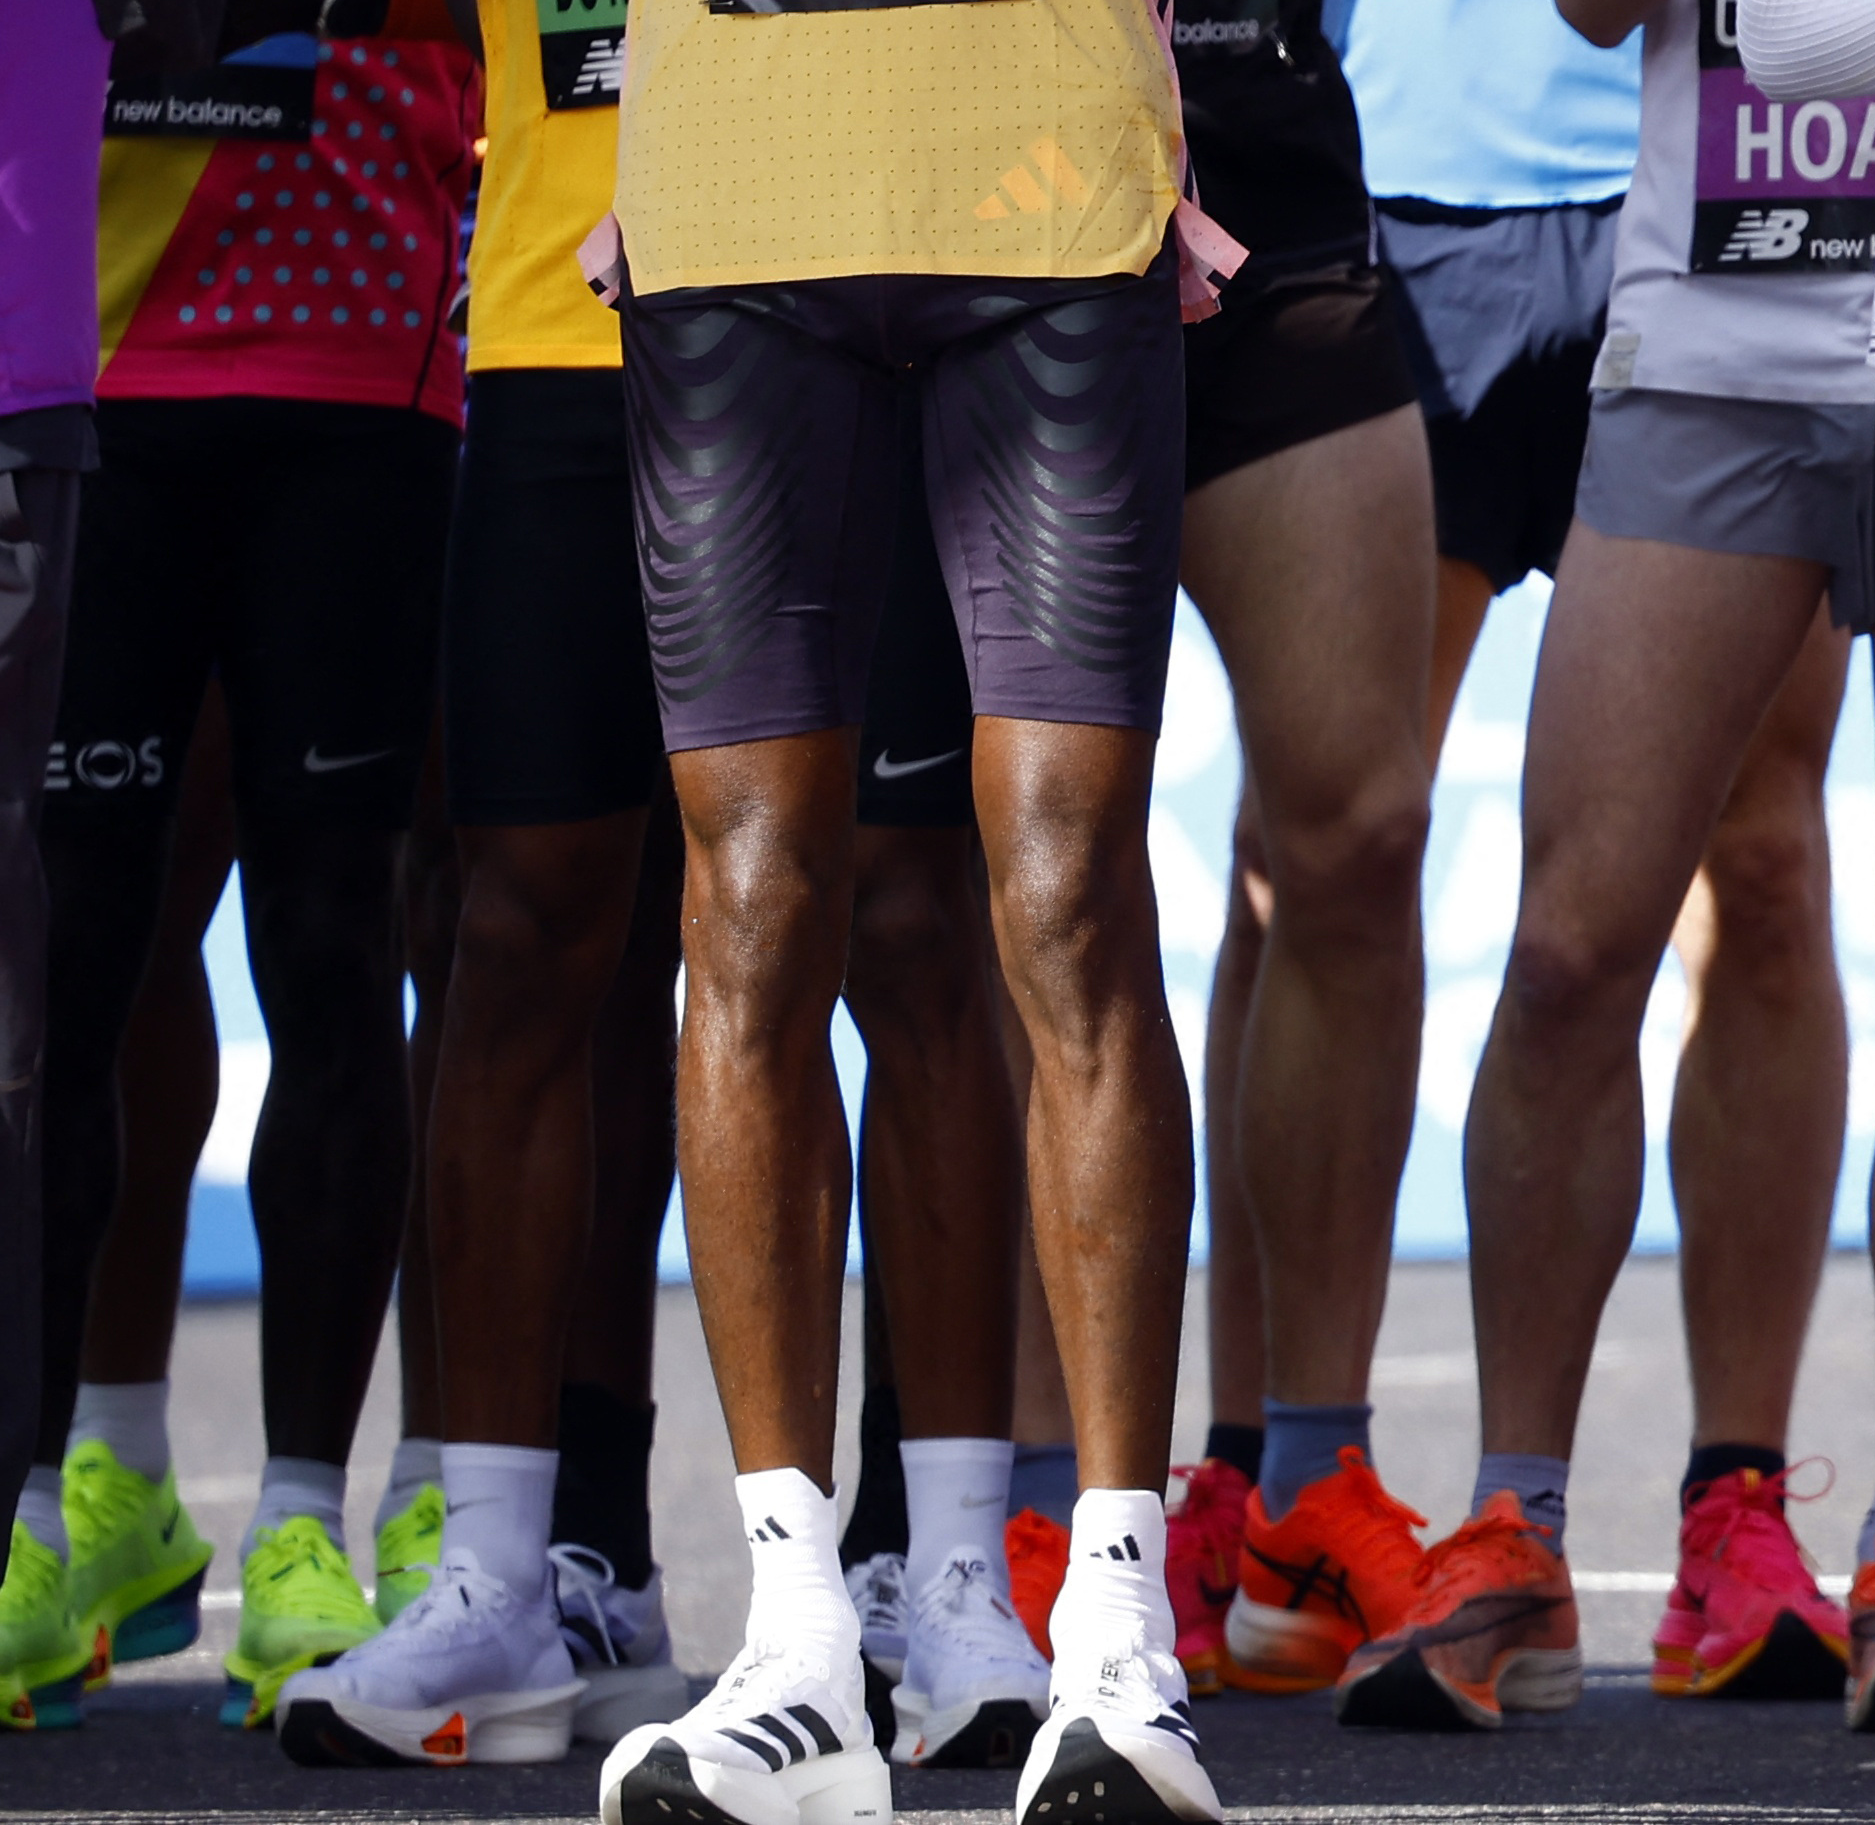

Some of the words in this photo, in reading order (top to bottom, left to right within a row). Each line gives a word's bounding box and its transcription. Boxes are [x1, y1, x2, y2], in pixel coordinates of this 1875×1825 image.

[113, 98, 163, 123] new
[167, 94, 284, 128] balance
[1718, 208, 1810, 262] NB
[1810, 238, 1864, 260] new
